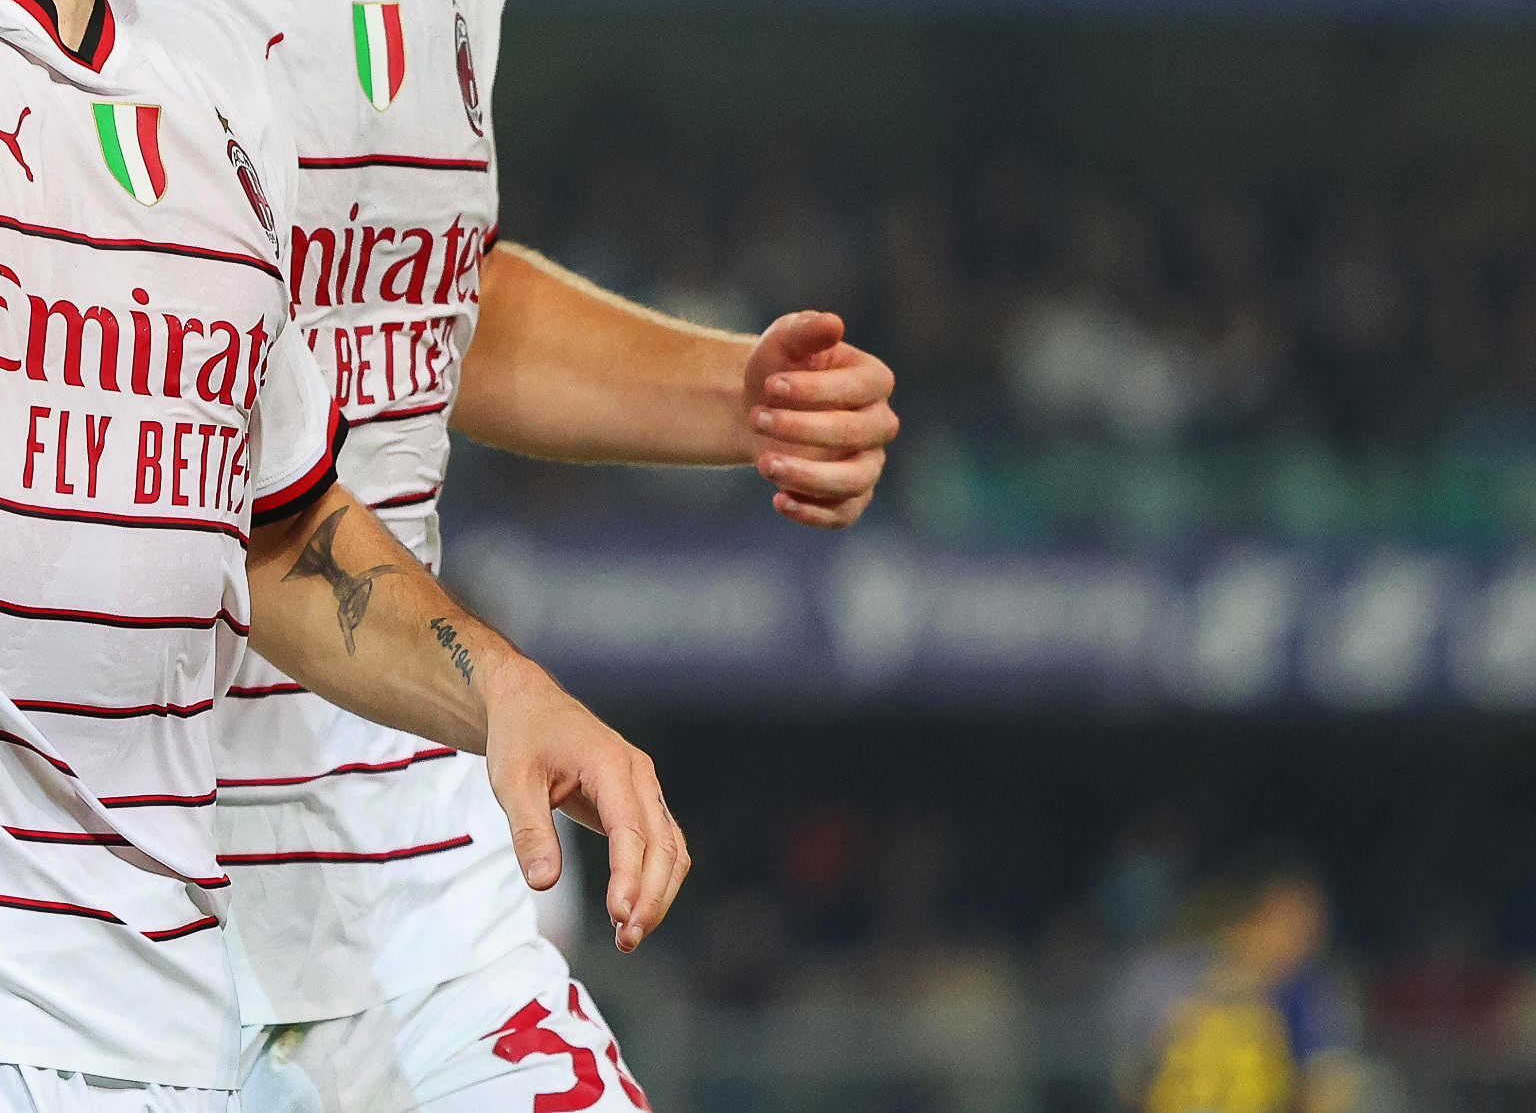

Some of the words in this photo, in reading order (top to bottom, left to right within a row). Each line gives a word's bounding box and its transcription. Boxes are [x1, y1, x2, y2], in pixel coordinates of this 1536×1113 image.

[334, 316, 456, 407] BETTE
[23, 406, 112, 498] FLY
[134, 420, 249, 514] BETTE
